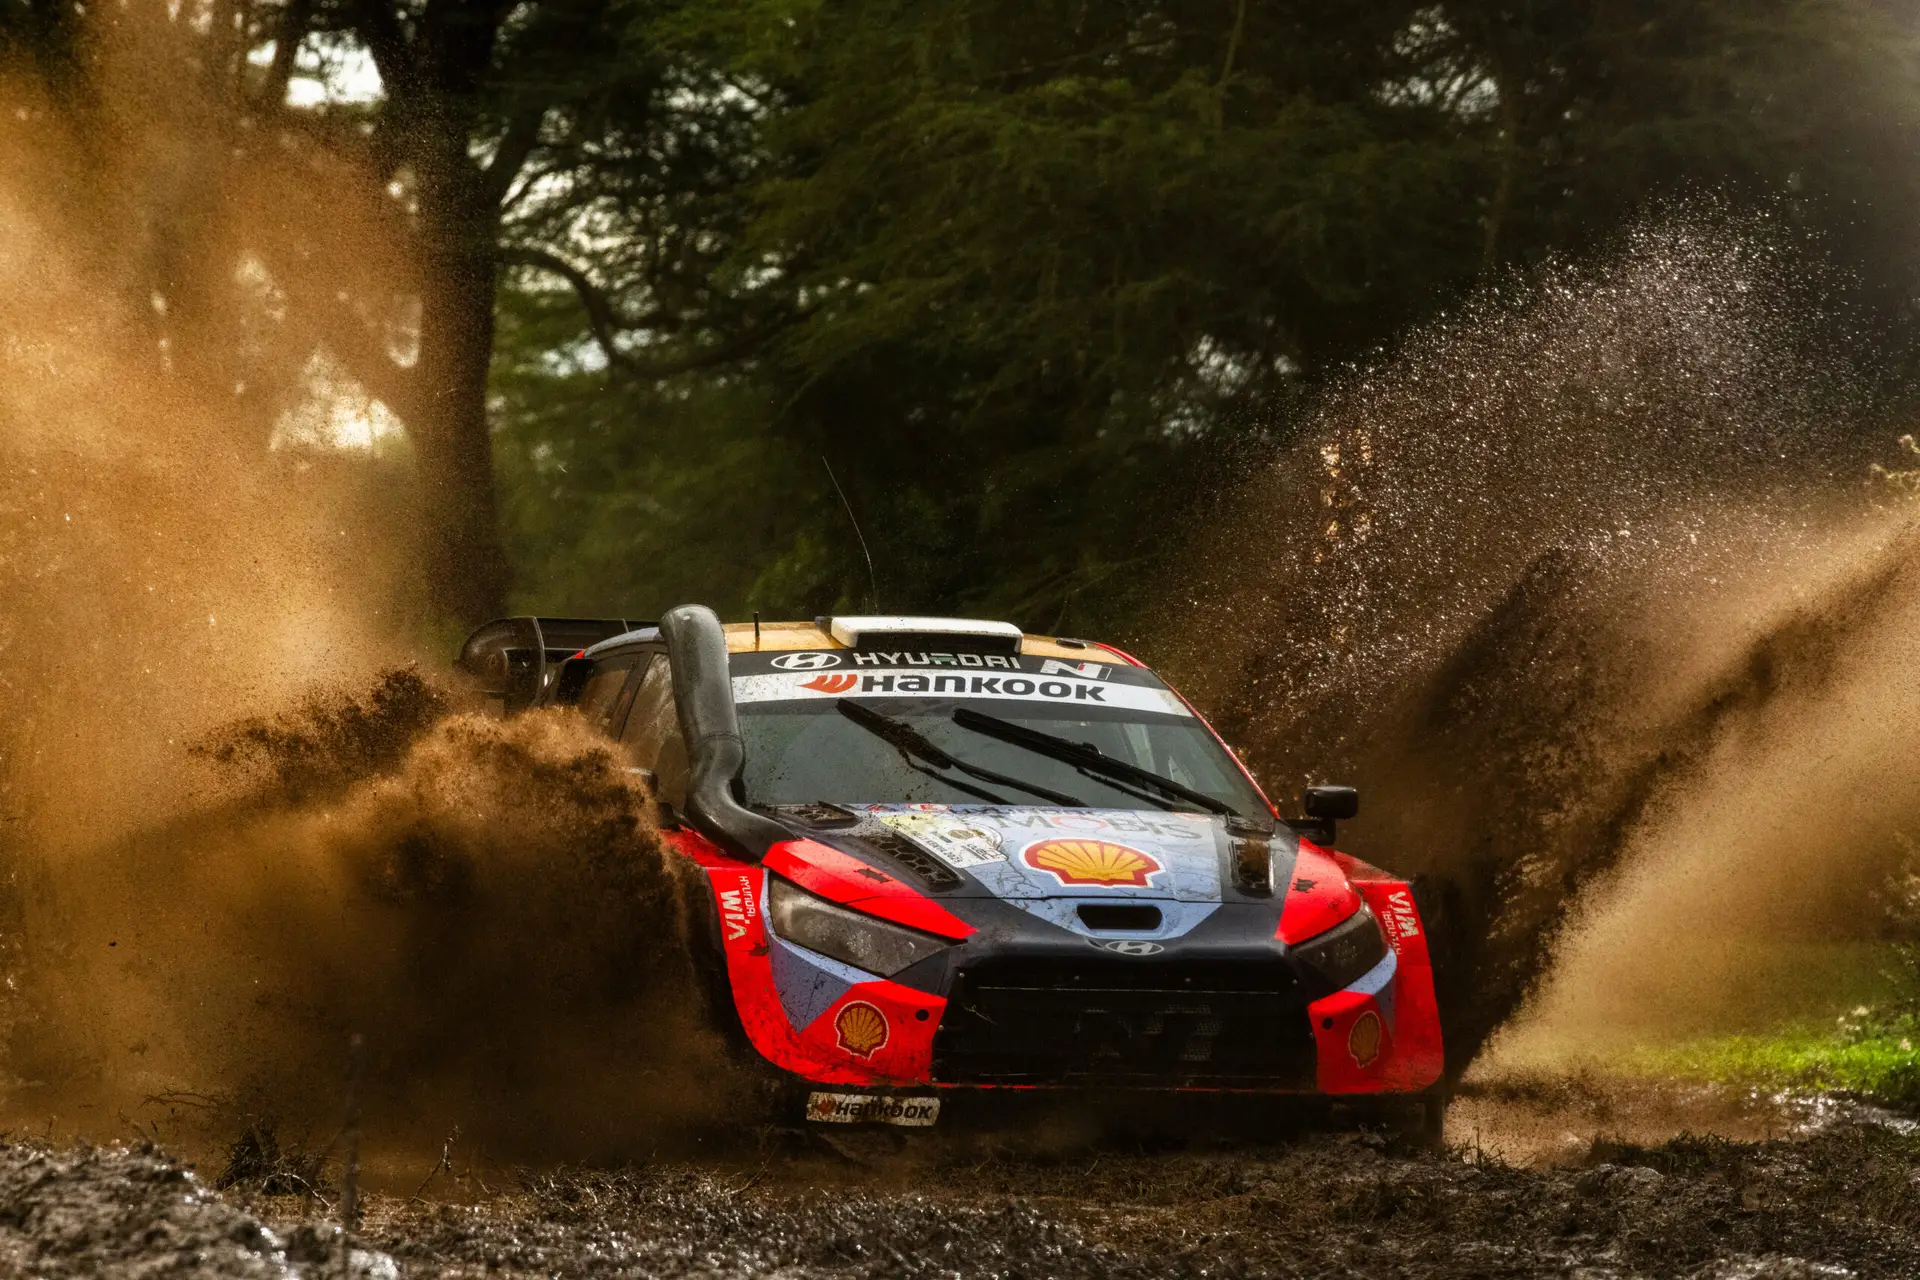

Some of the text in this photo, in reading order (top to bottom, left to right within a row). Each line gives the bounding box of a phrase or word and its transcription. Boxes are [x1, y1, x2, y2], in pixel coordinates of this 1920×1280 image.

[853, 652, 1022, 669] HYUNDAI
[992, 814, 1203, 839] MOBIS
[738, 875, 756, 917] HYUNDAI
[1381, 910, 1403, 955] HYUNDAI
